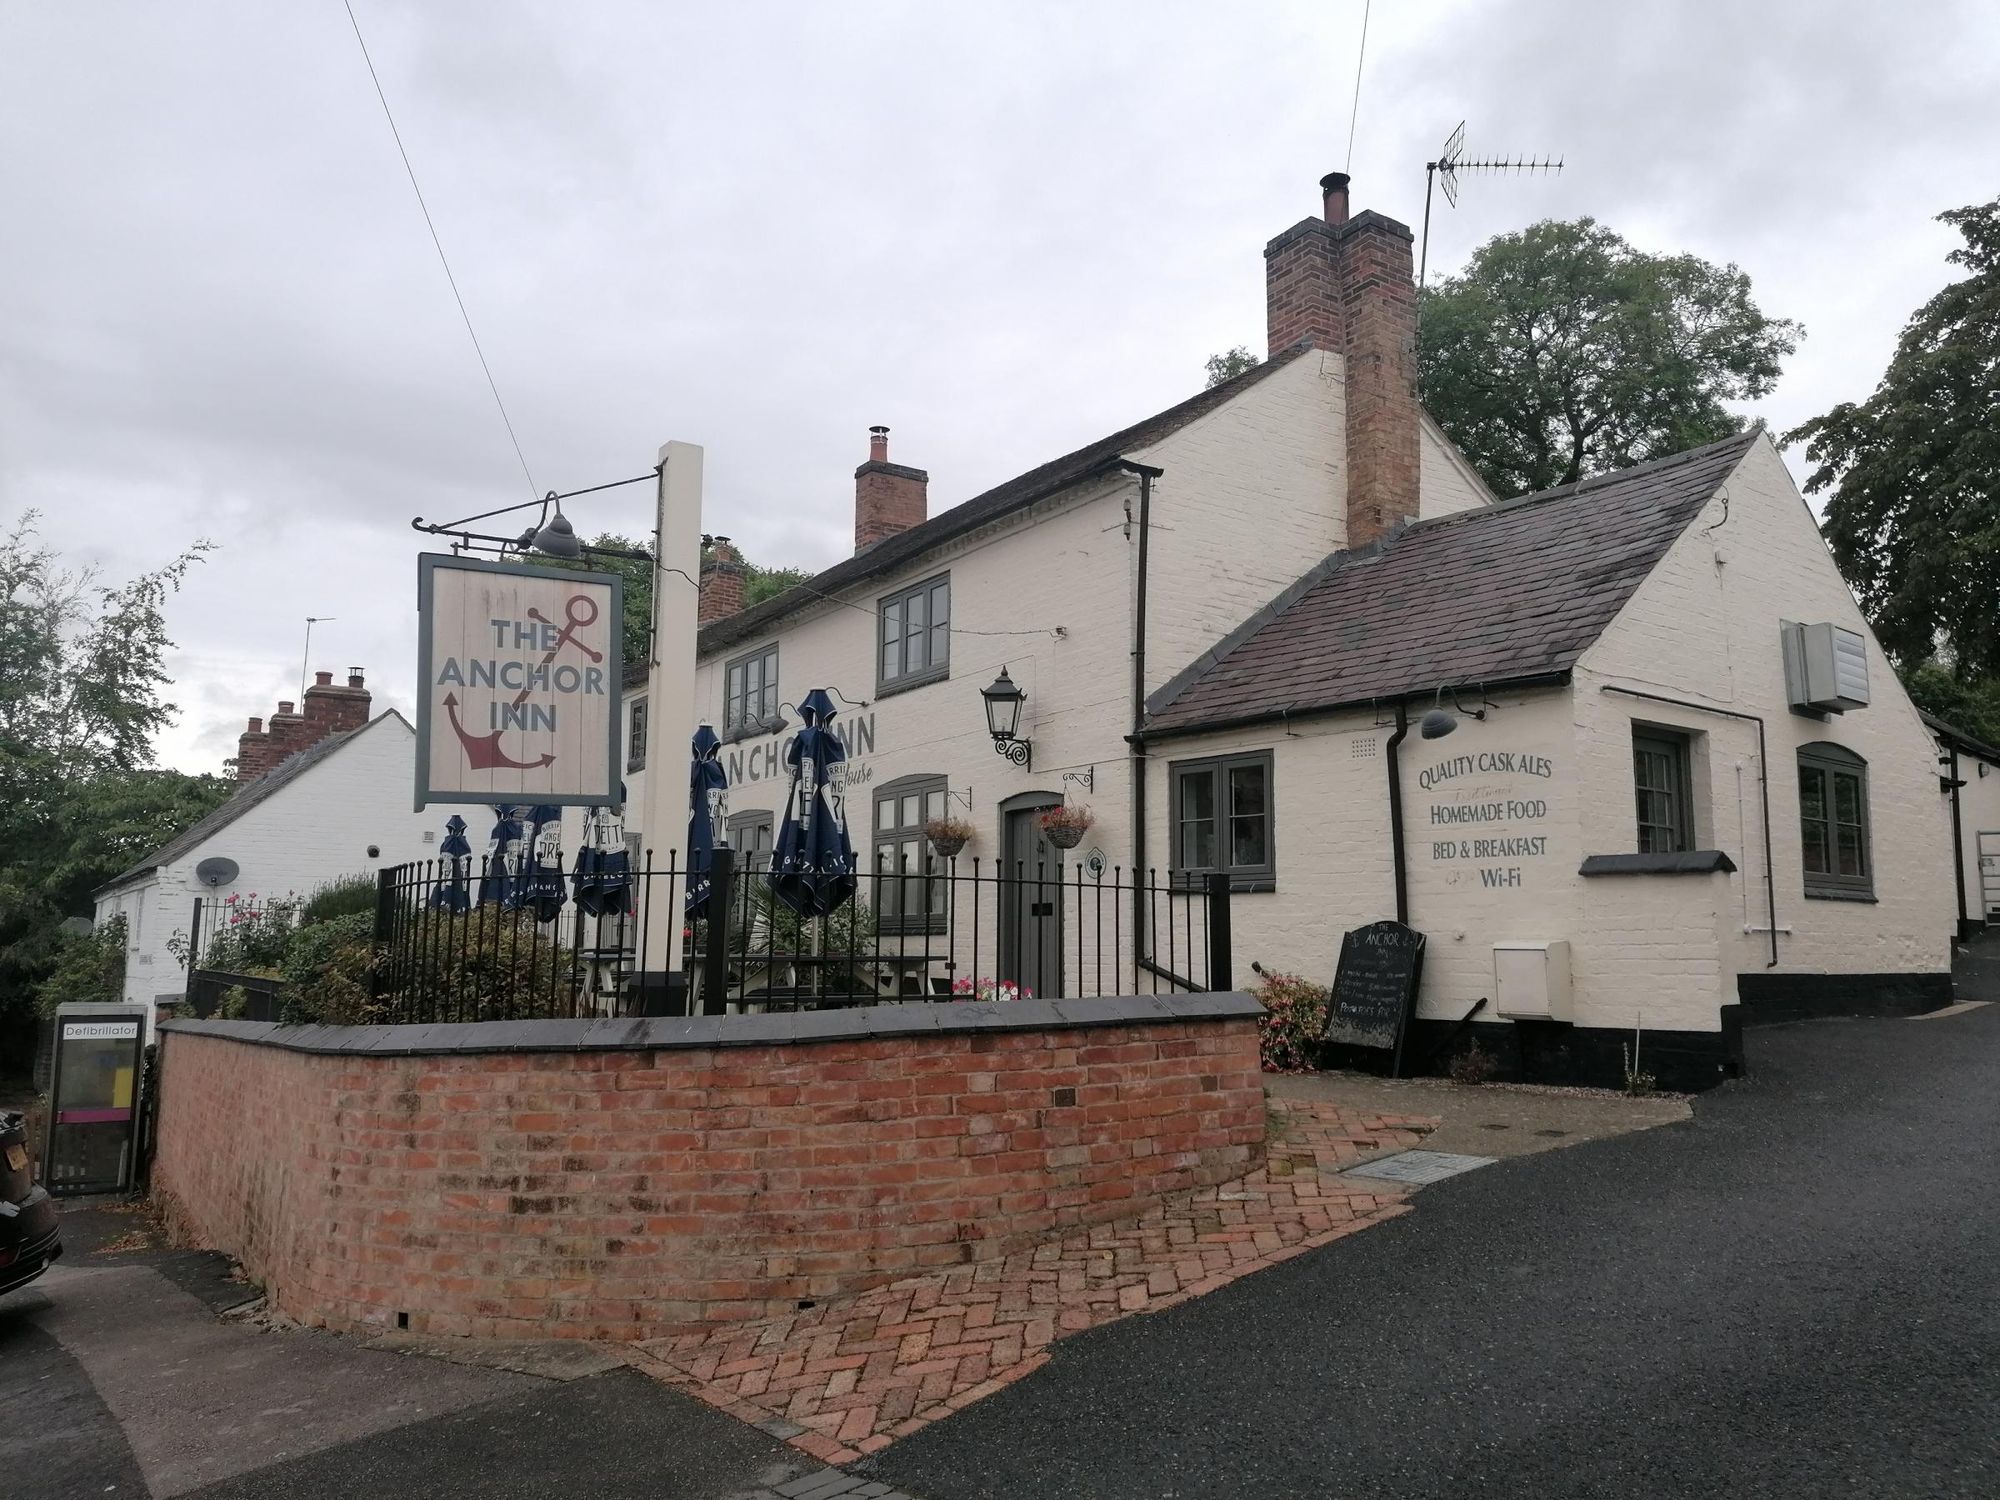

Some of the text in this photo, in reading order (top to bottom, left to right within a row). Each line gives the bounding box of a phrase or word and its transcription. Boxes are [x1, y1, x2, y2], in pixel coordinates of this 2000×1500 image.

[491, 619, 558, 653] THE
[437, 657, 604, 695] ANCHOR
[490, 702, 556, 732] INN
[1419, 753, 1552, 790] QUALITY CASK ALES
[1431, 800, 1547, 824] HOMEMADE FOOD
[1433, 837, 1547, 859] BED & BREAKFAST
[66, 1026, 136, 1036] Defibrillator
